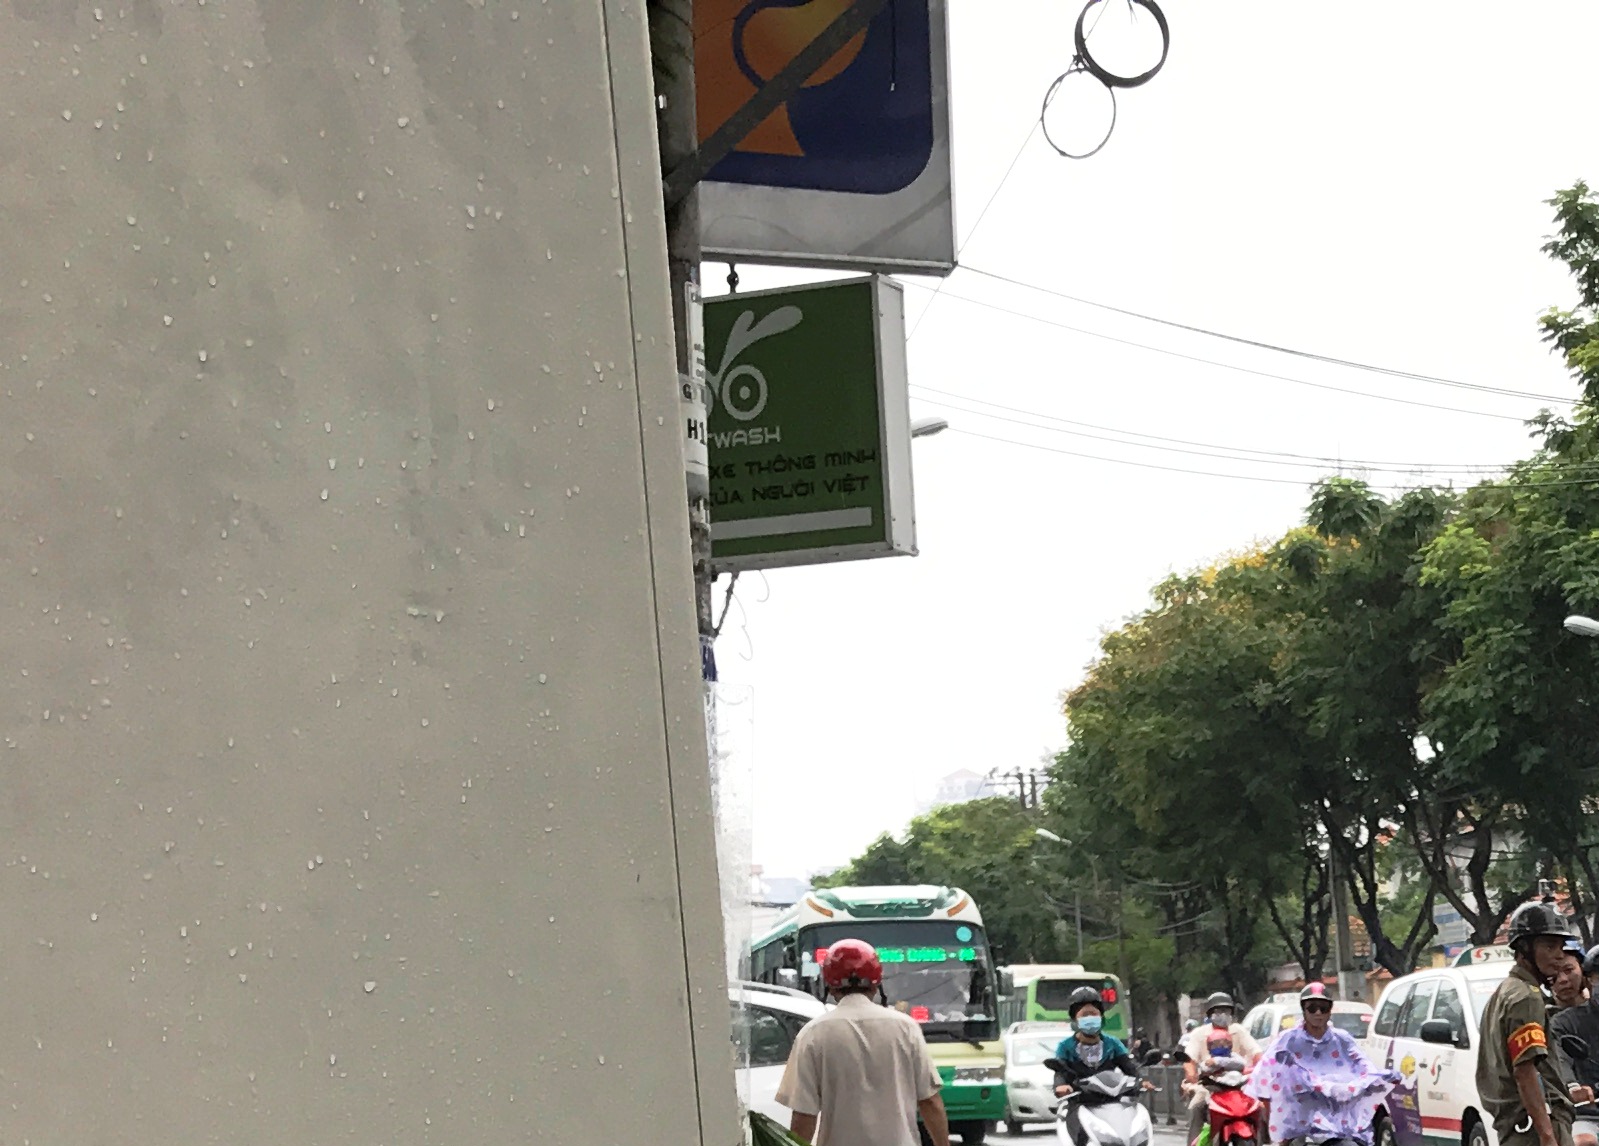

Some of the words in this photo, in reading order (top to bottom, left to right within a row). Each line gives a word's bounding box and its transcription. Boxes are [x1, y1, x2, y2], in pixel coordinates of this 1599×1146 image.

[708, 425, 782, 449] WASH
[745, 453, 816, 475] THÔNG
[825, 448, 876, 467] MINH
[823, 472, 870, 495] VIỆT
[1514, 1029, 1547, 1048] TTG
